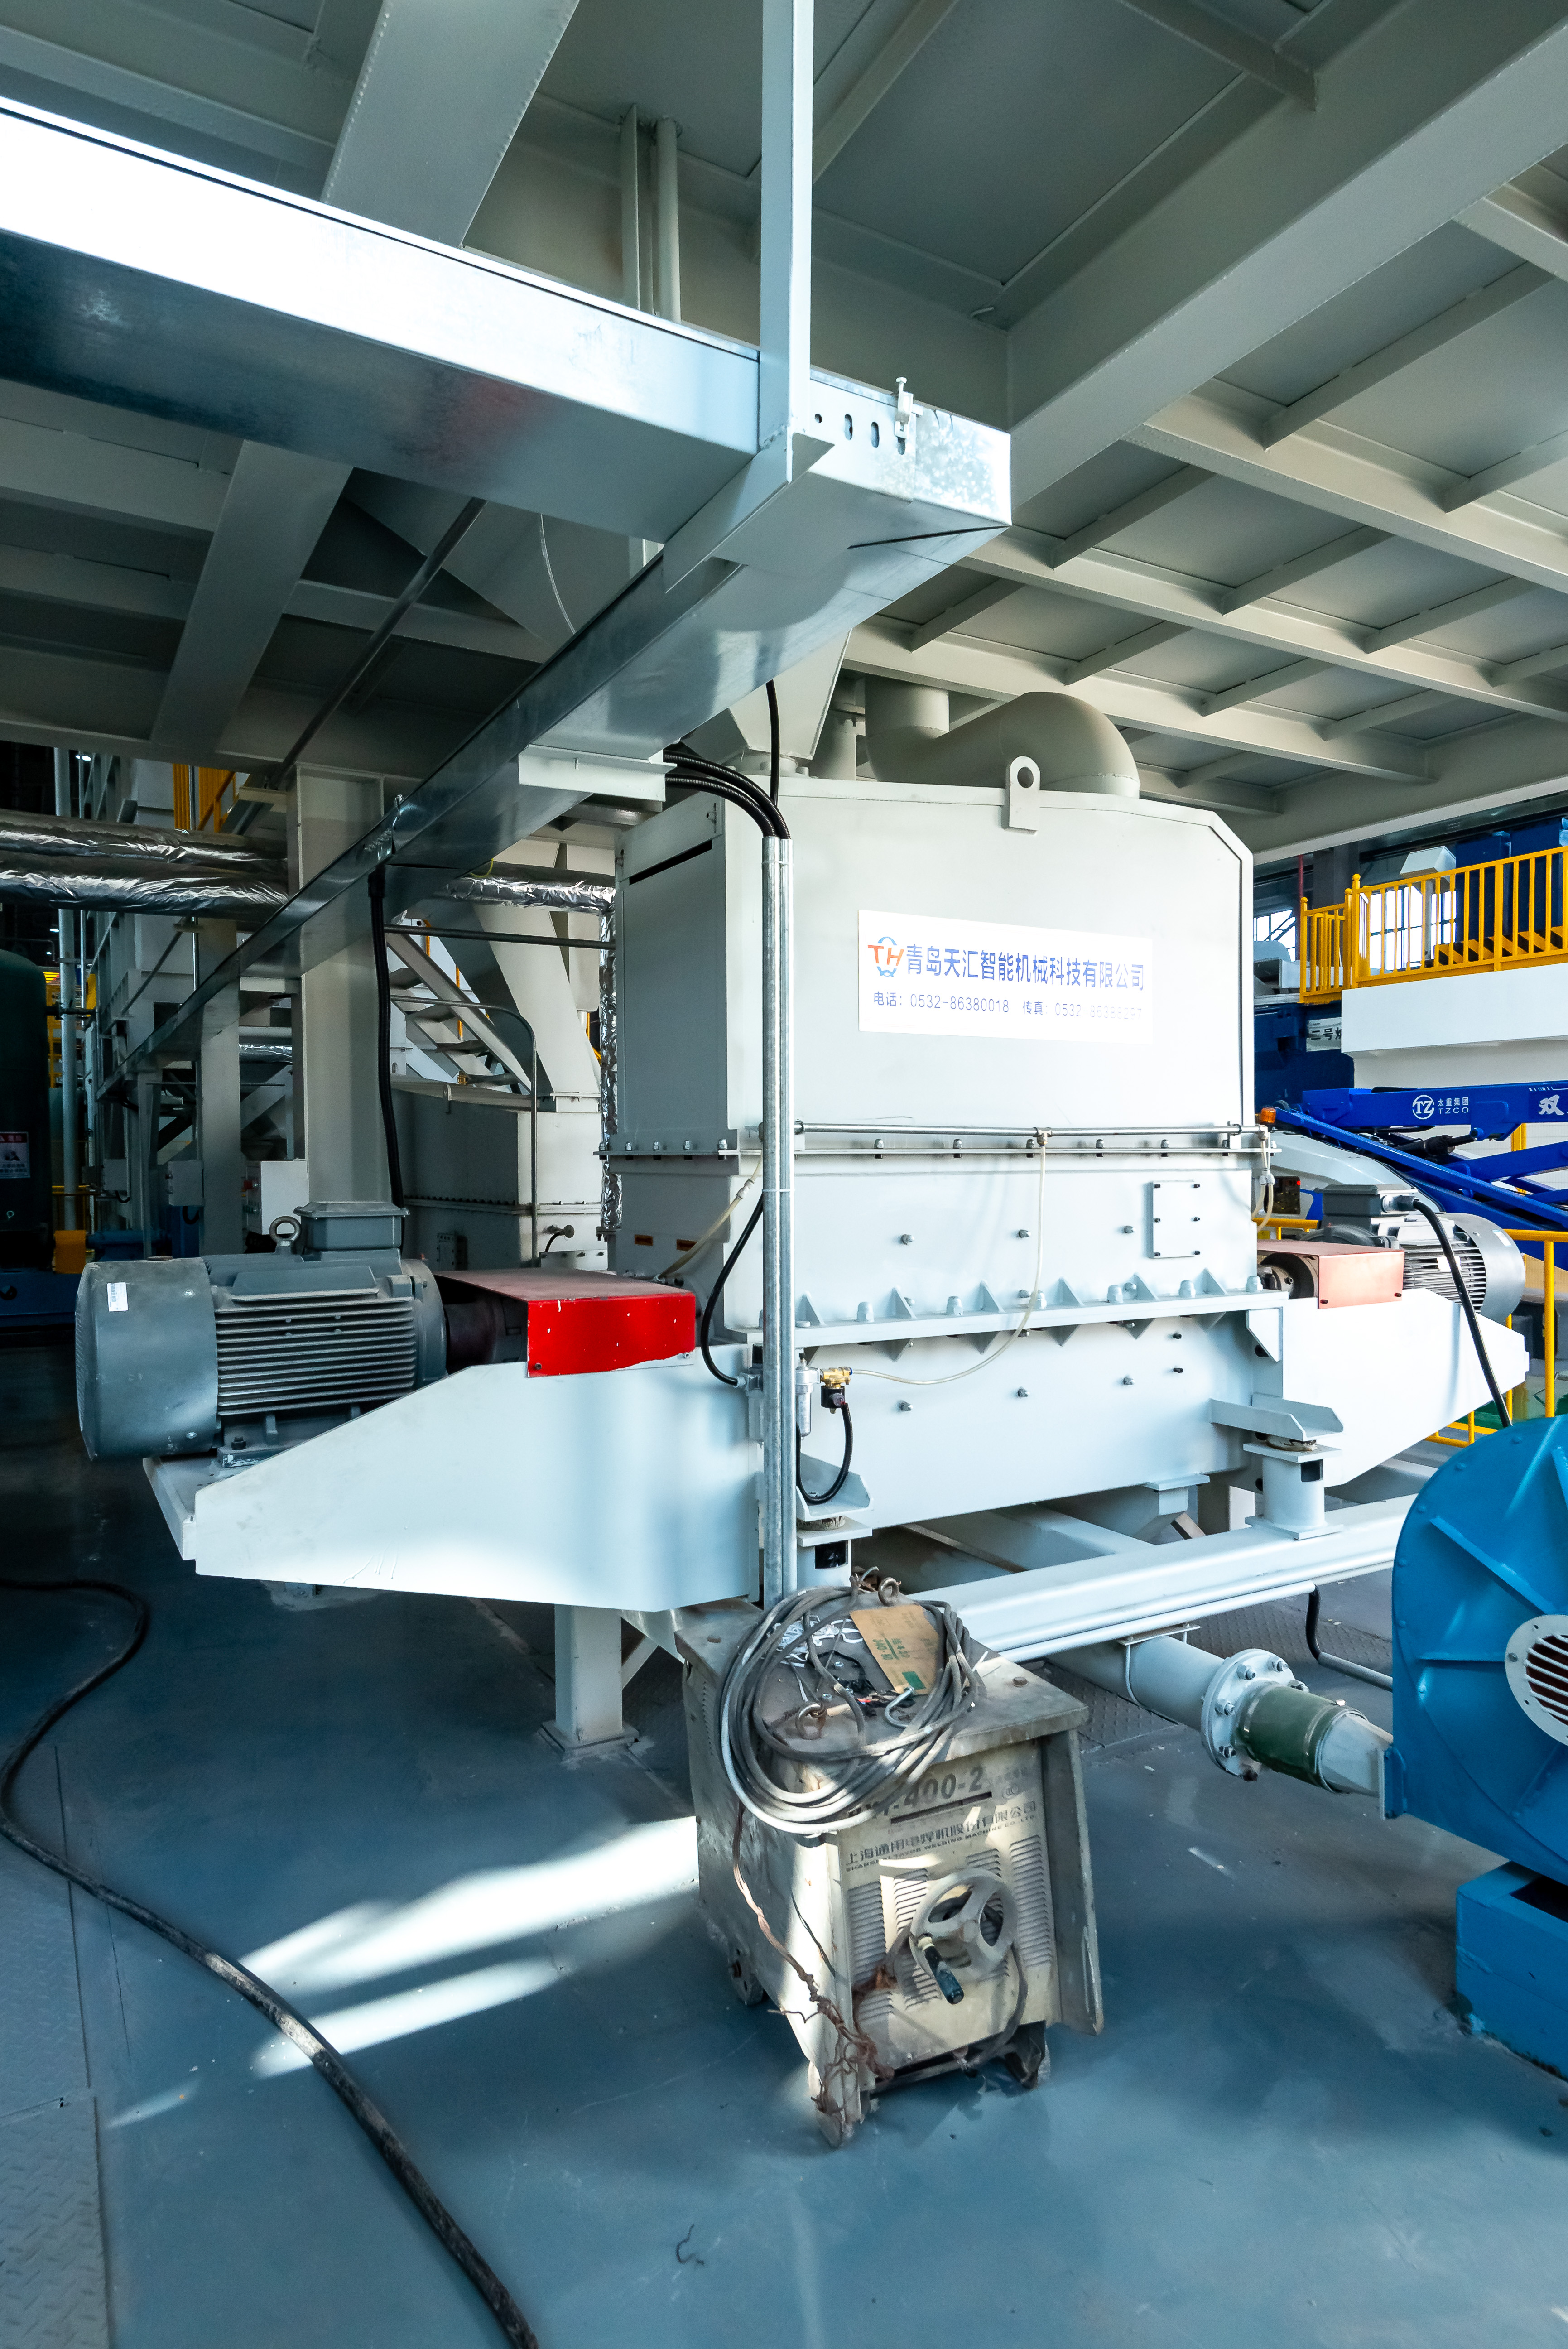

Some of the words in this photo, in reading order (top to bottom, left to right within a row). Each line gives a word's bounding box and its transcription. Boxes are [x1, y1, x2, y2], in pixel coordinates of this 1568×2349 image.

[867, 944, 904, 966] TH
[906, 943, 1144, 991] 青岛天汇智能机械科技有限公司
[1437, 1097, 1469, 1107] 太重集团
